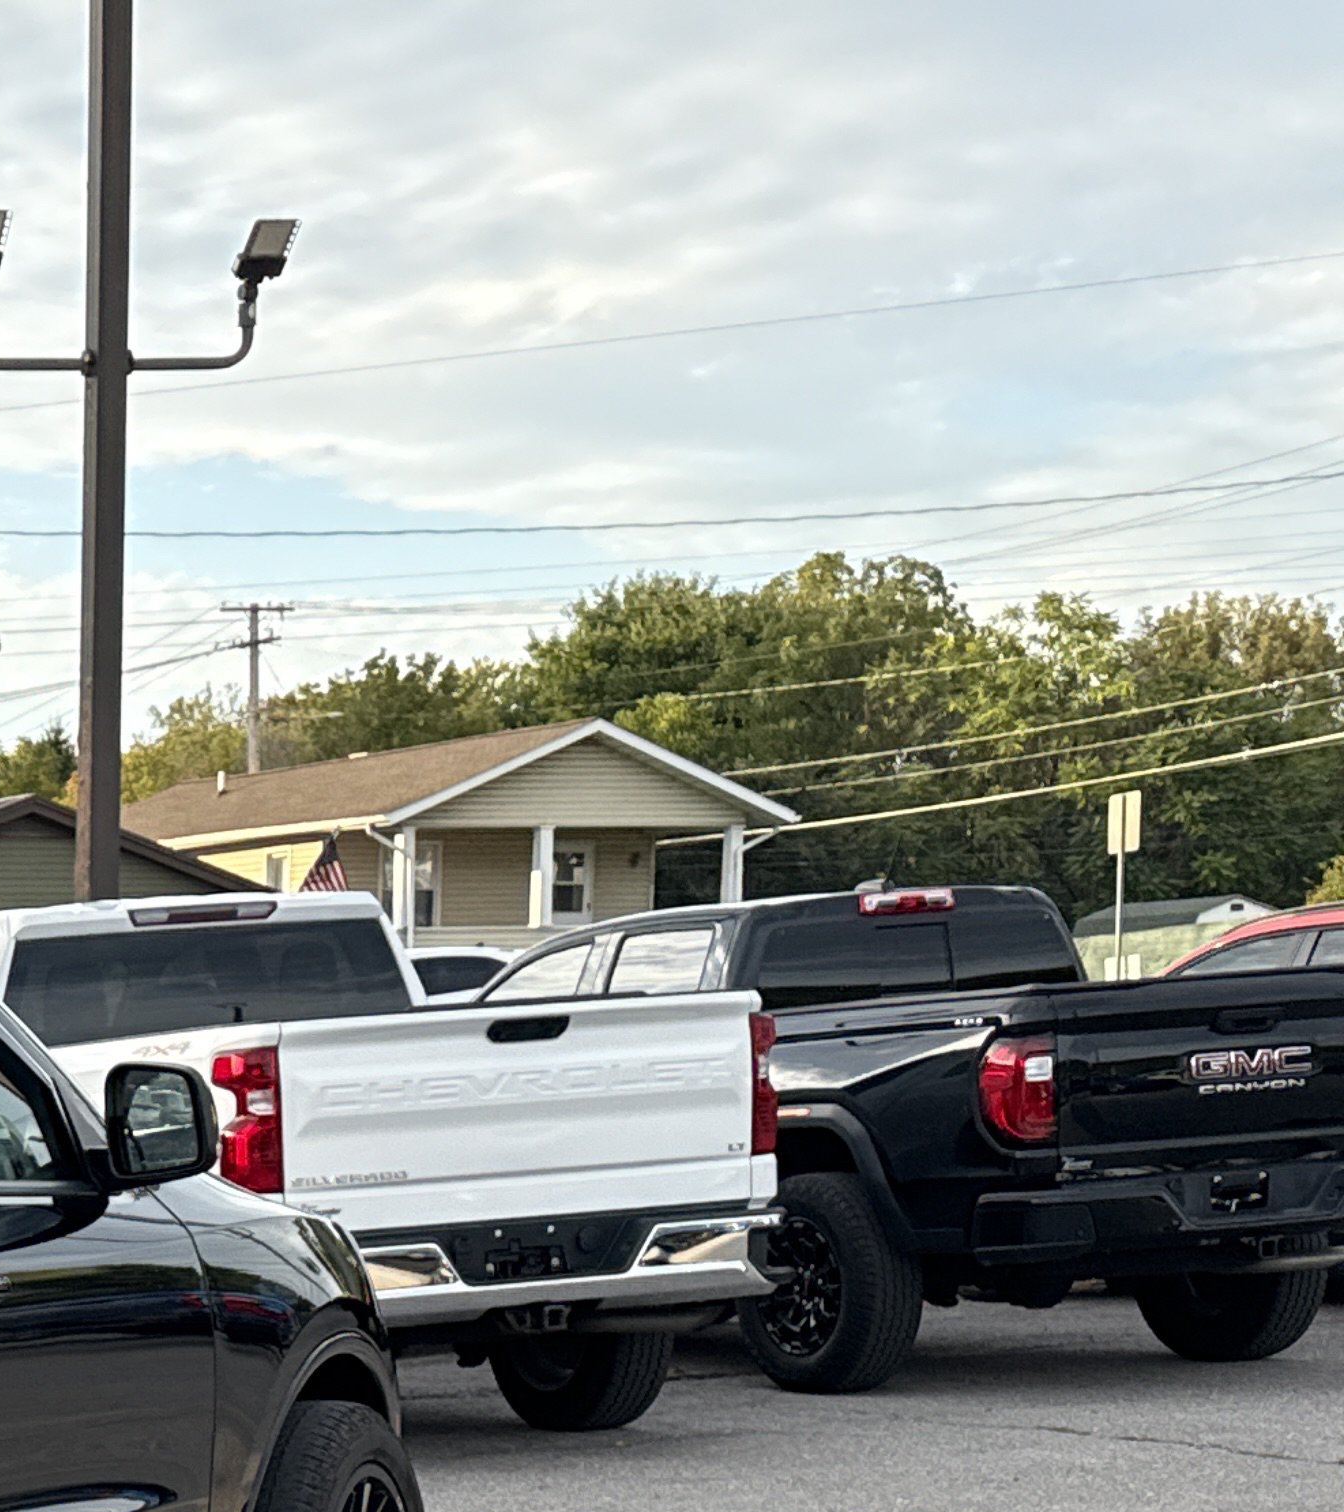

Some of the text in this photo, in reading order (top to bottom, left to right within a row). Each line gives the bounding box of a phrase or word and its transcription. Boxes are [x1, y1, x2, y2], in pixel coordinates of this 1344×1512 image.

[1190, 1046, 1311, 1079] GMC
[319, 1056, 731, 1110] CHEVROLET
[1198, 1078, 1305, 1095] CANYON
[292, 1170, 408, 1187] SILVERADO
